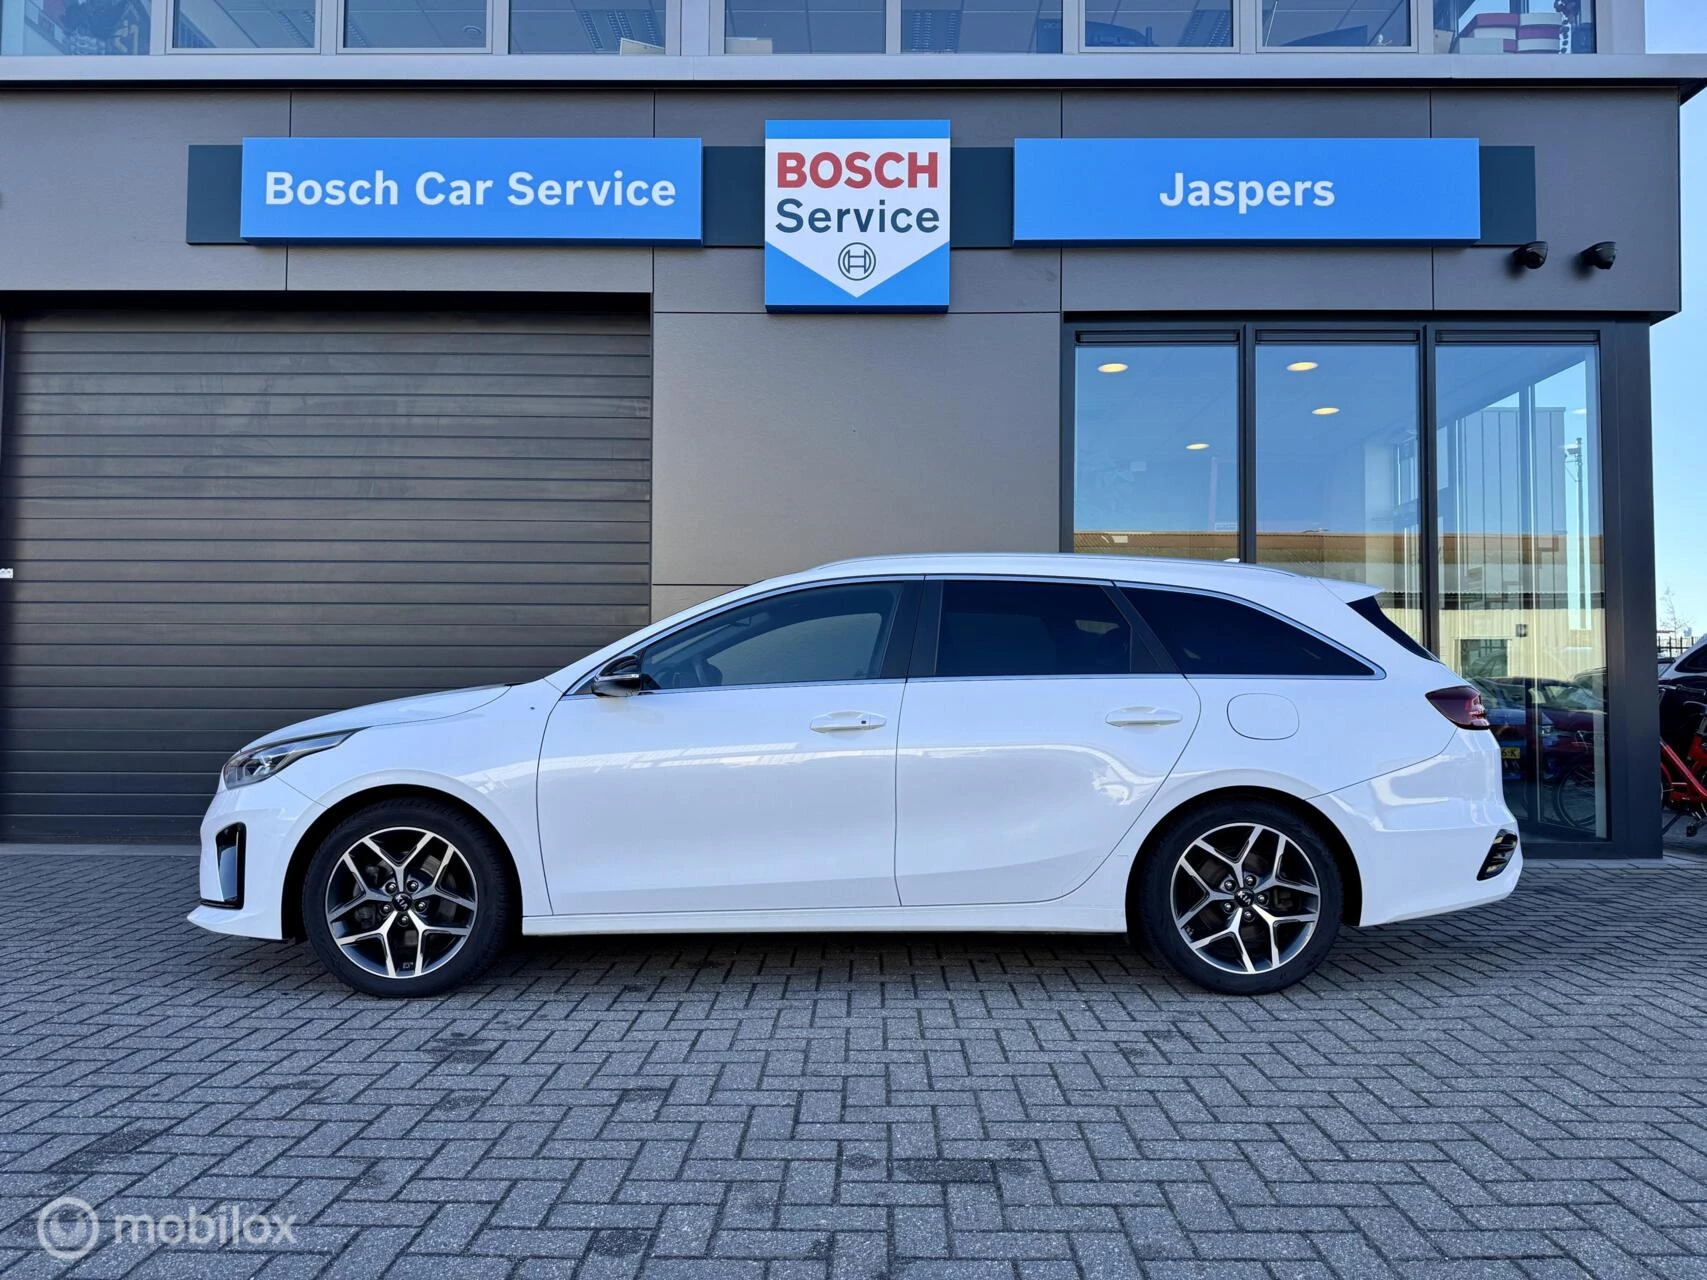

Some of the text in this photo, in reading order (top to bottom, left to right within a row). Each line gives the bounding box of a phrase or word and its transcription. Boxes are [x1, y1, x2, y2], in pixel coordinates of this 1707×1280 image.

[265, 169, 676, 207] Bosch Car Service
[777, 151, 938, 189] BOSCH
[1159, 172, 1335, 215] Jaspers
[775, 198, 940, 234] Service
[395, 894, 408, 910] KIA
[1237, 890, 1251, 905] KIA
